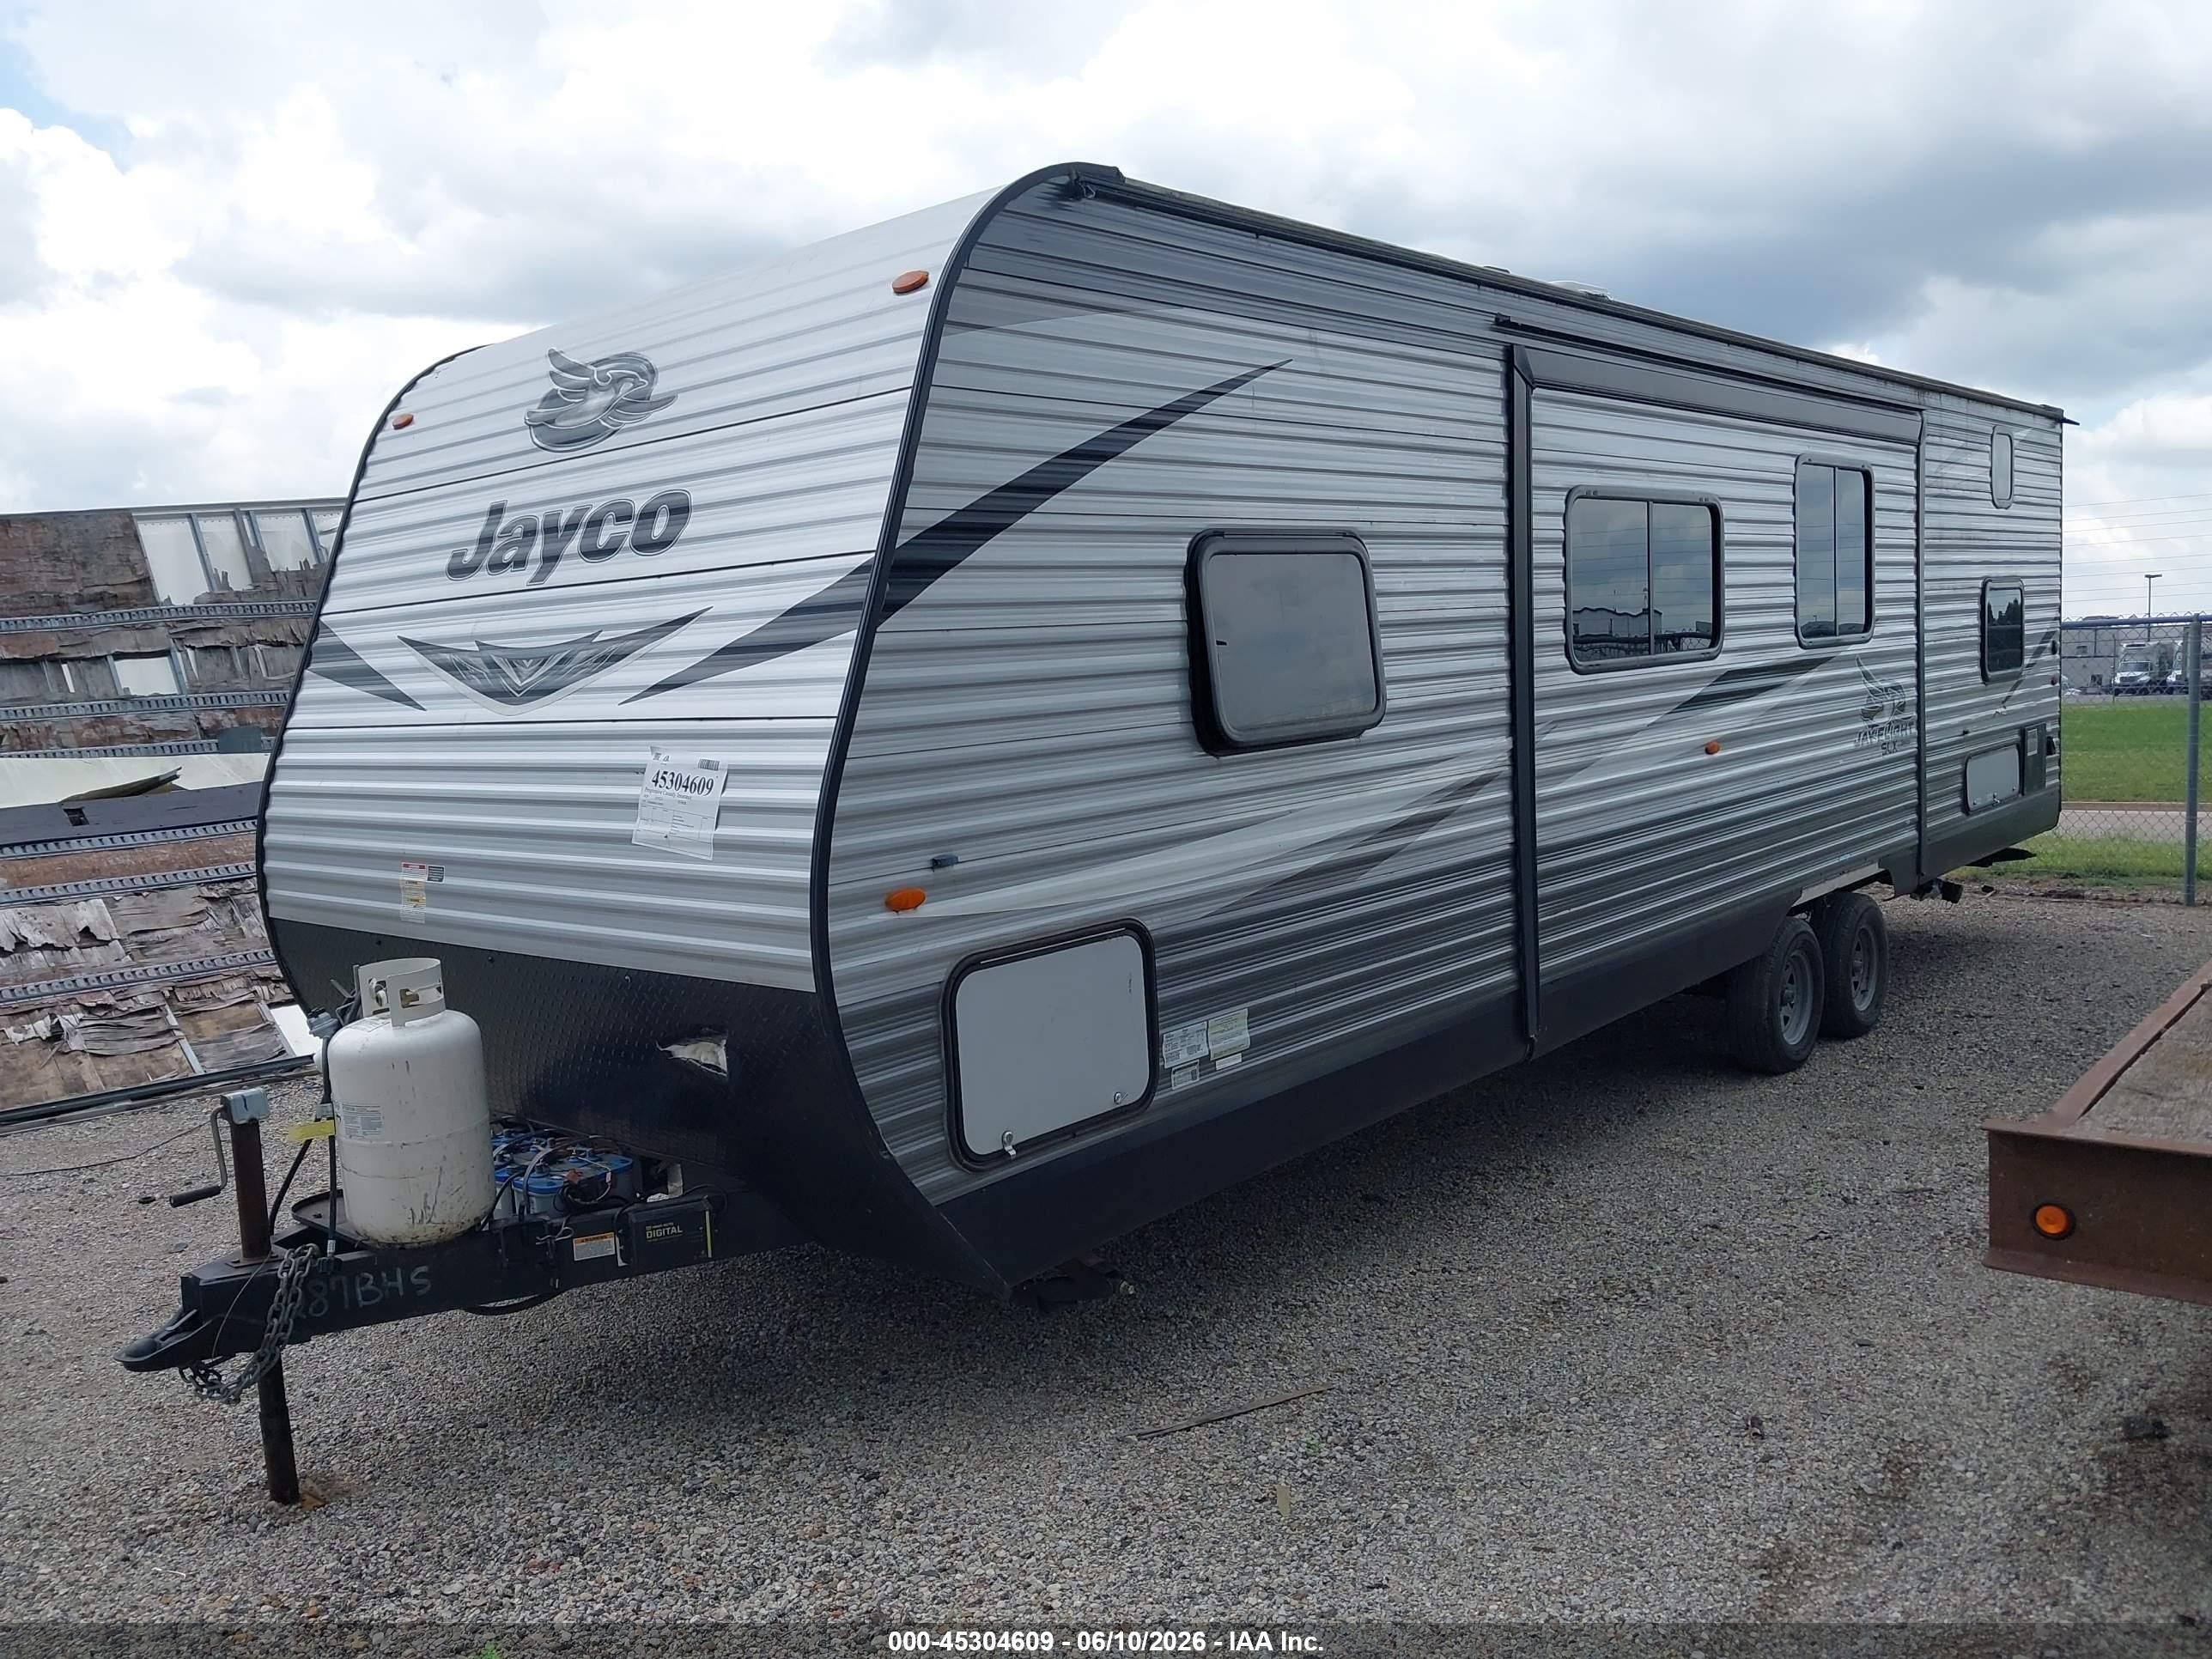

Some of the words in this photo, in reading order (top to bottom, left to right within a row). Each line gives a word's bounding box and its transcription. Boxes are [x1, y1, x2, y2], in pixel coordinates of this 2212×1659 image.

[446, 489, 692, 586] Jayco
[652, 769, 714, 797] 45304609
[646, 1225, 684, 1239] DIGITAL
[295, 1266, 431, 1319] 87BHS
